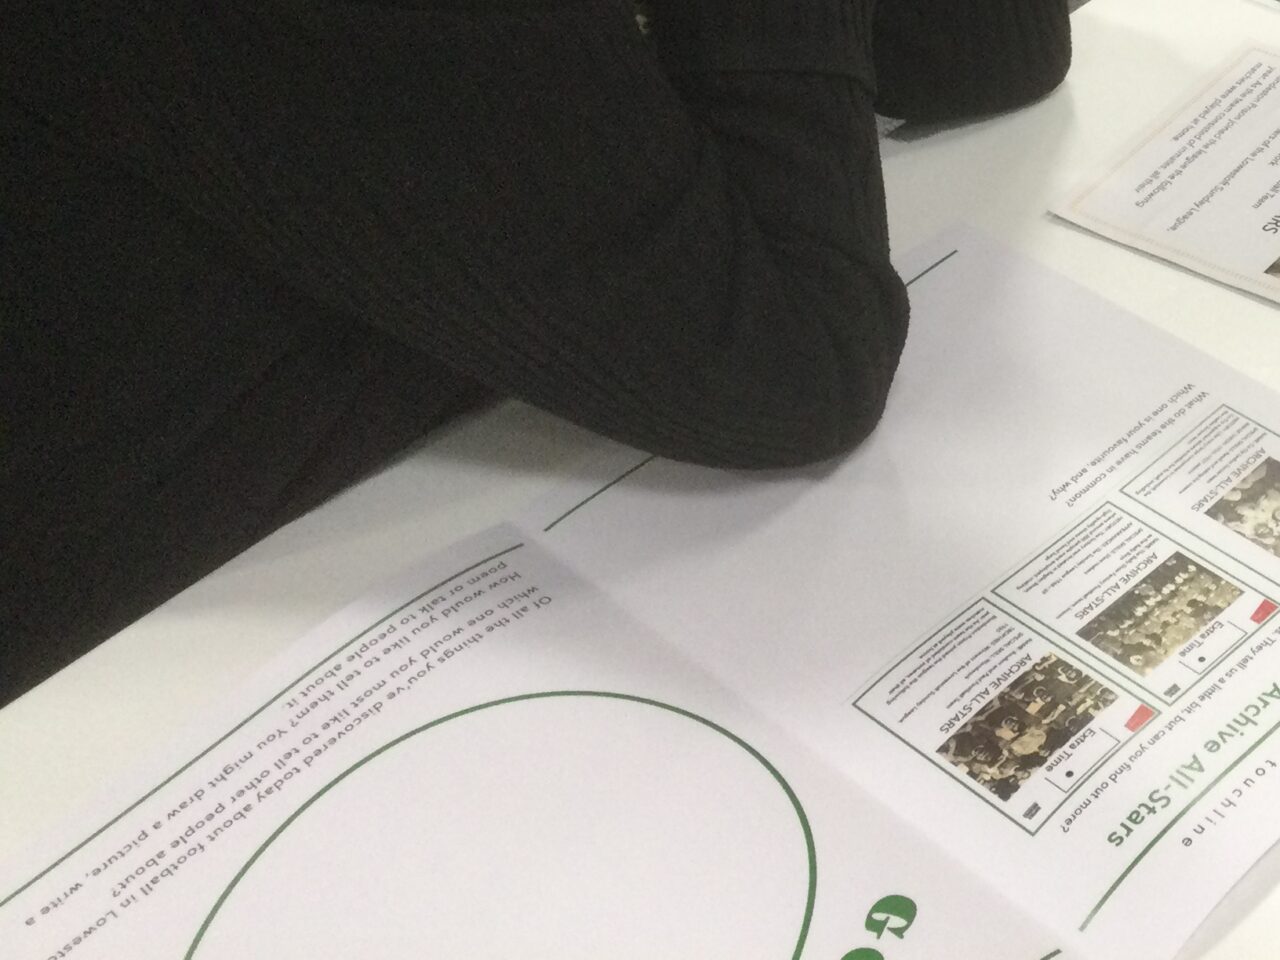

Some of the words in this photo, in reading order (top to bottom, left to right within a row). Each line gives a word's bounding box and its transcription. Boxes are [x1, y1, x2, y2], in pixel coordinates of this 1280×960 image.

[1183, 390, 1211, 410] What
[1158, 416, 1177, 431] the
[1172, 406, 1187, 419] do
[1134, 428, 1163, 451] teams
[1114, 447, 1140, 467] have
[1104, 464, 1118, 475] in
[1064, 471, 1108, 509] common?
[496, 585, 540, 610] which
[531, 595, 553, 610] Of
[466, 608, 496, 628] one
[510, 604, 530, 621] all
[484, 616, 512, 634] the
[1198, 619, 1225, 641] Extra
[418, 626, 466, 661] would
[435, 632, 485, 665] things
[1177, 638, 1205, 658] Time
[1249, 635, 1278, 657] They
[388, 655, 418, 680] you
[987, 652, 1034, 691] ARCHIVE
[1223, 666, 1239, 679] us
[1234, 653, 1255, 671] tell
[385, 660, 436, 701] you've
[1216, 675, 1227, 685] a
[349, 678, 388, 709] most
[1196, 682, 1224, 703] little
[938, 686, 992, 735] ALL-STARS
[1180, 699, 1203, 715] bit,
[320, 707, 352, 732] like
[1163, 713, 1187, 732] but
[301, 700, 385, 769] discovered
[301, 731, 321, 747] to
[1067, 726, 1097, 751] Extra
[1146, 728, 1167, 747] can
[272, 746, 301, 771] tell
[1043, 749, 1074, 774] Time
[1127, 743, 1150, 764] you
[255, 765, 302, 804] today
[1107, 761, 1133, 785] find
[229, 768, 272, 805] other
[1088, 780, 1111, 800] out
[1105, 752, 1206, 848] All-Stars
[1180, 758, 1278, 848] touchline
[168, 801, 227, 850] people
[205, 802, 254, 843] about
[1059, 796, 1093, 834] more?
[111, 849, 167, 899] about?
[138, 841, 206, 897] football
[118, 893, 138, 909] in
